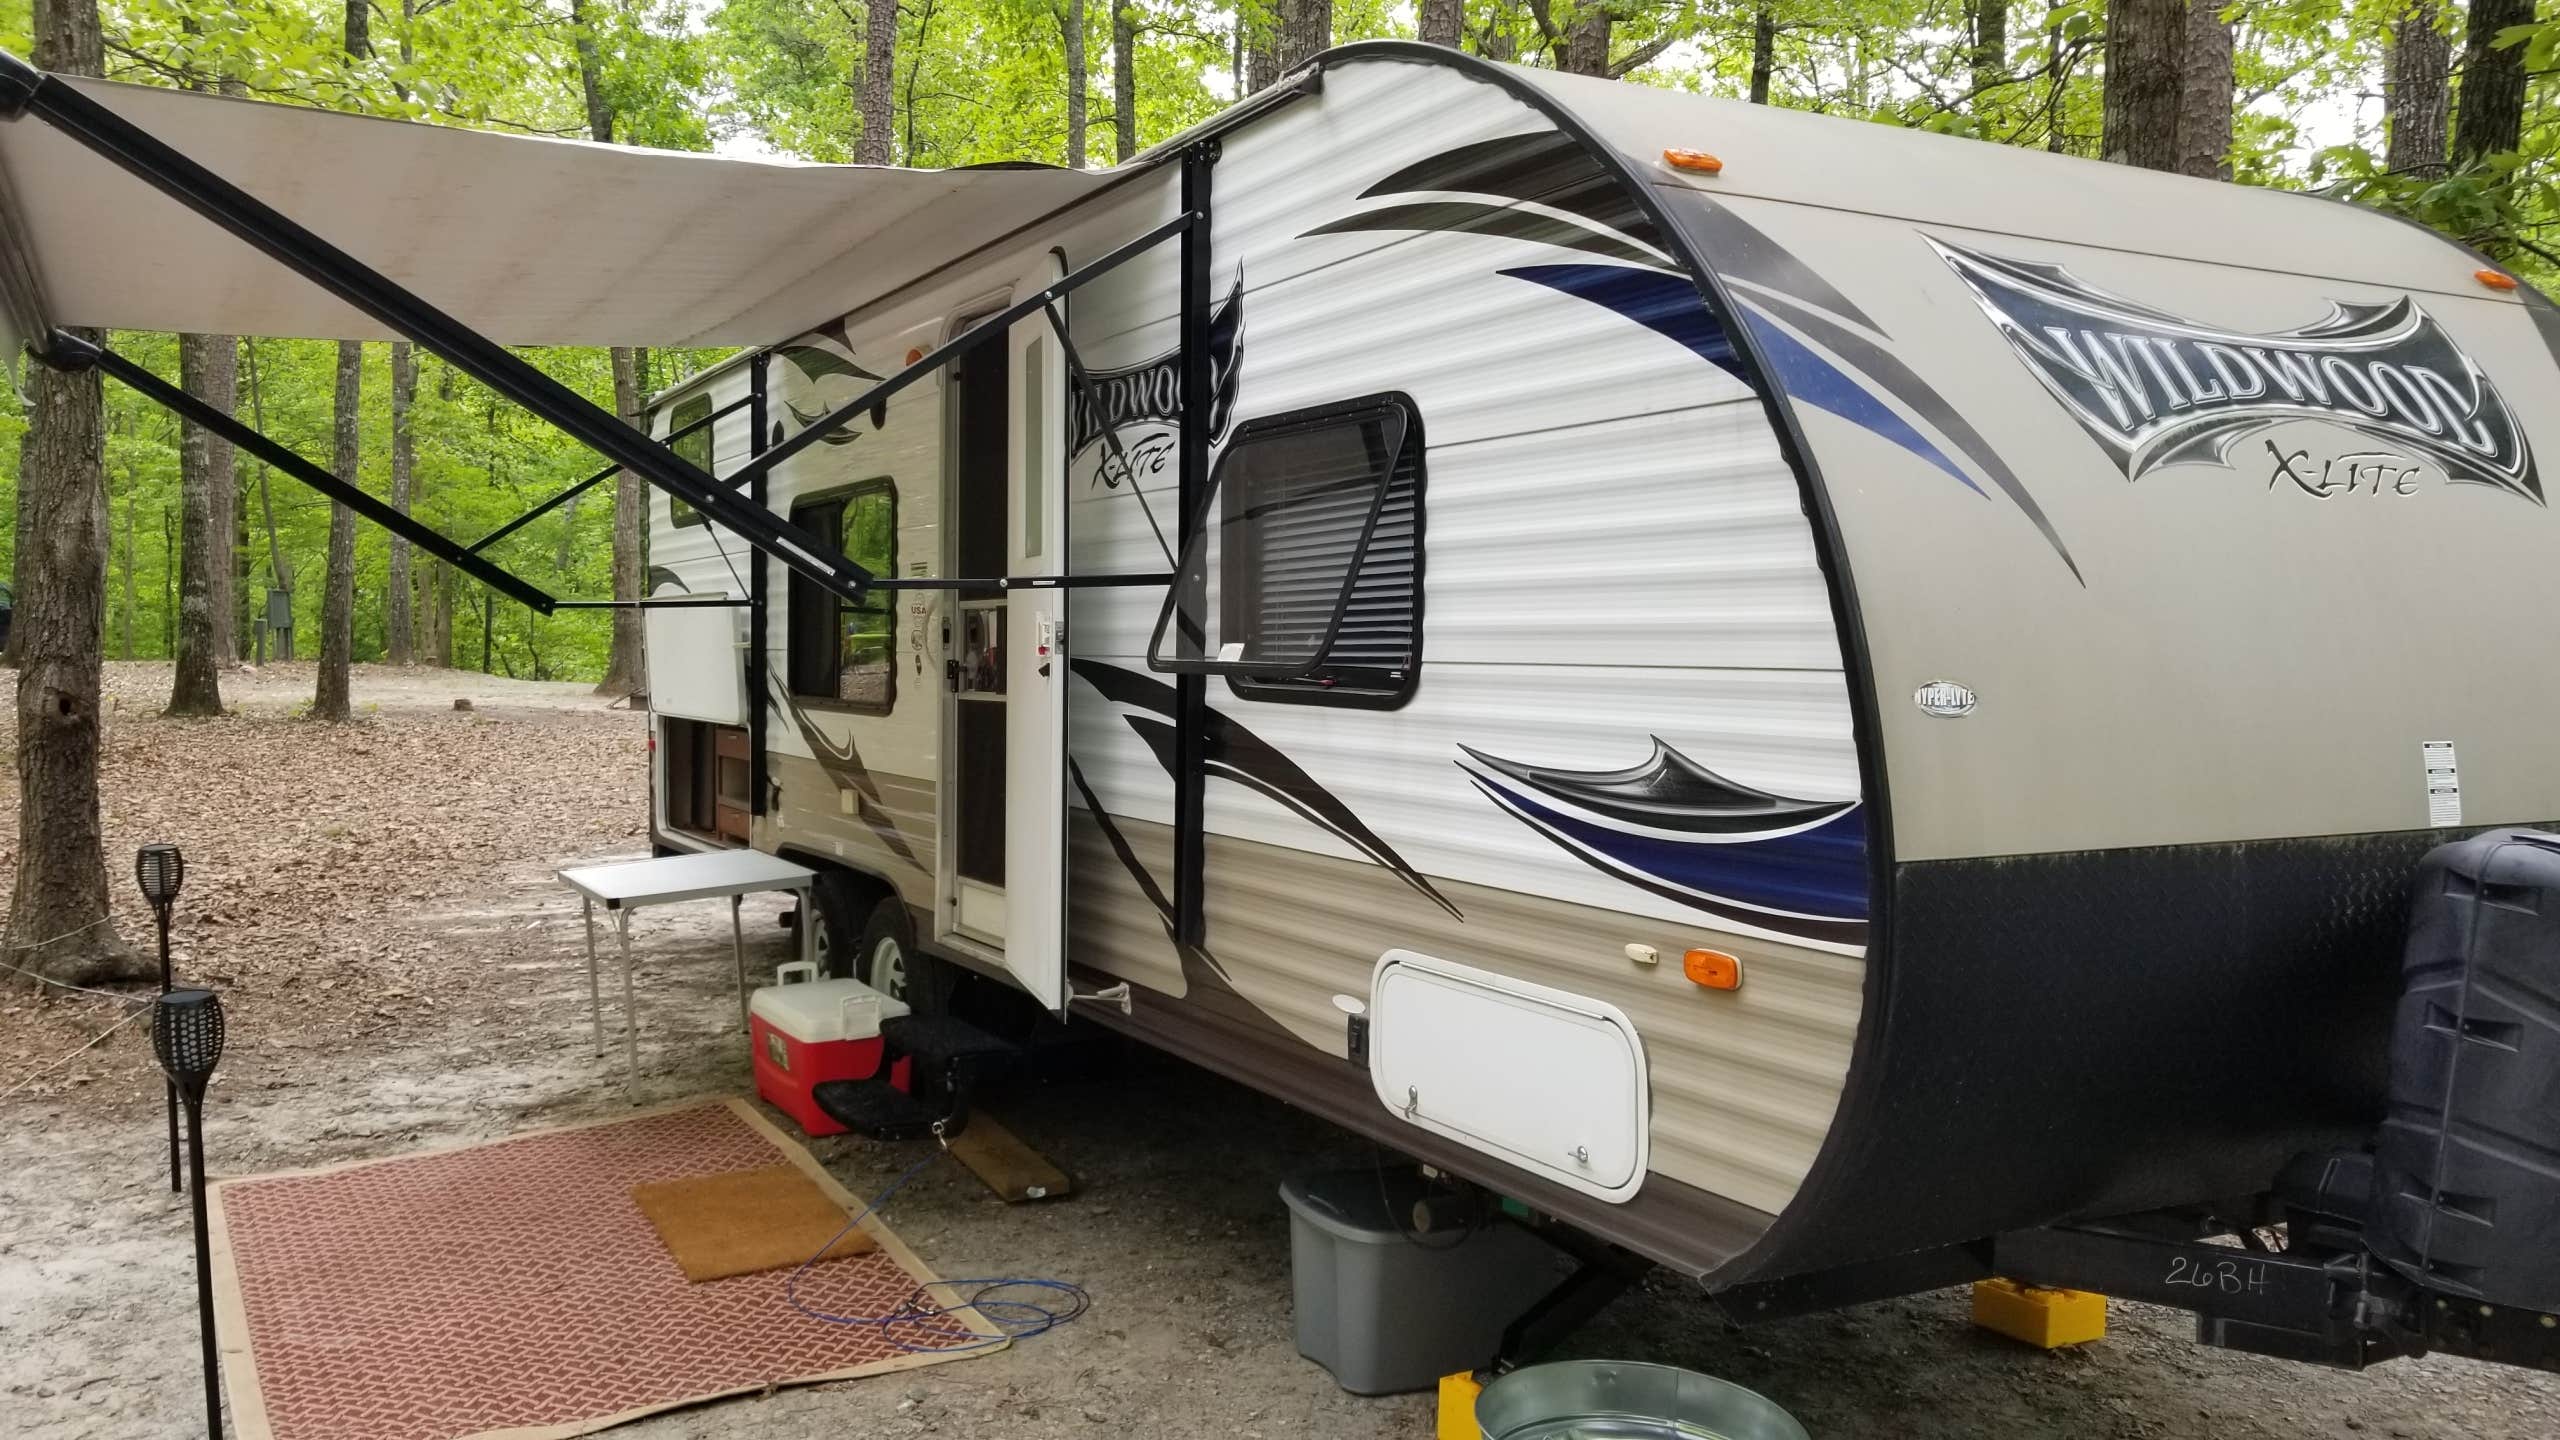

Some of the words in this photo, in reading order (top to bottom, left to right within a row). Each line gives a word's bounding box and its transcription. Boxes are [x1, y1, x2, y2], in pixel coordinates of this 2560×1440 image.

[2044, 326, 2499, 458] WILDWOOD
[2265, 439, 2421, 499] X-LITE
[911, 605, 927, 615] USA
[2165, 1257, 2270, 1296] 26BH
